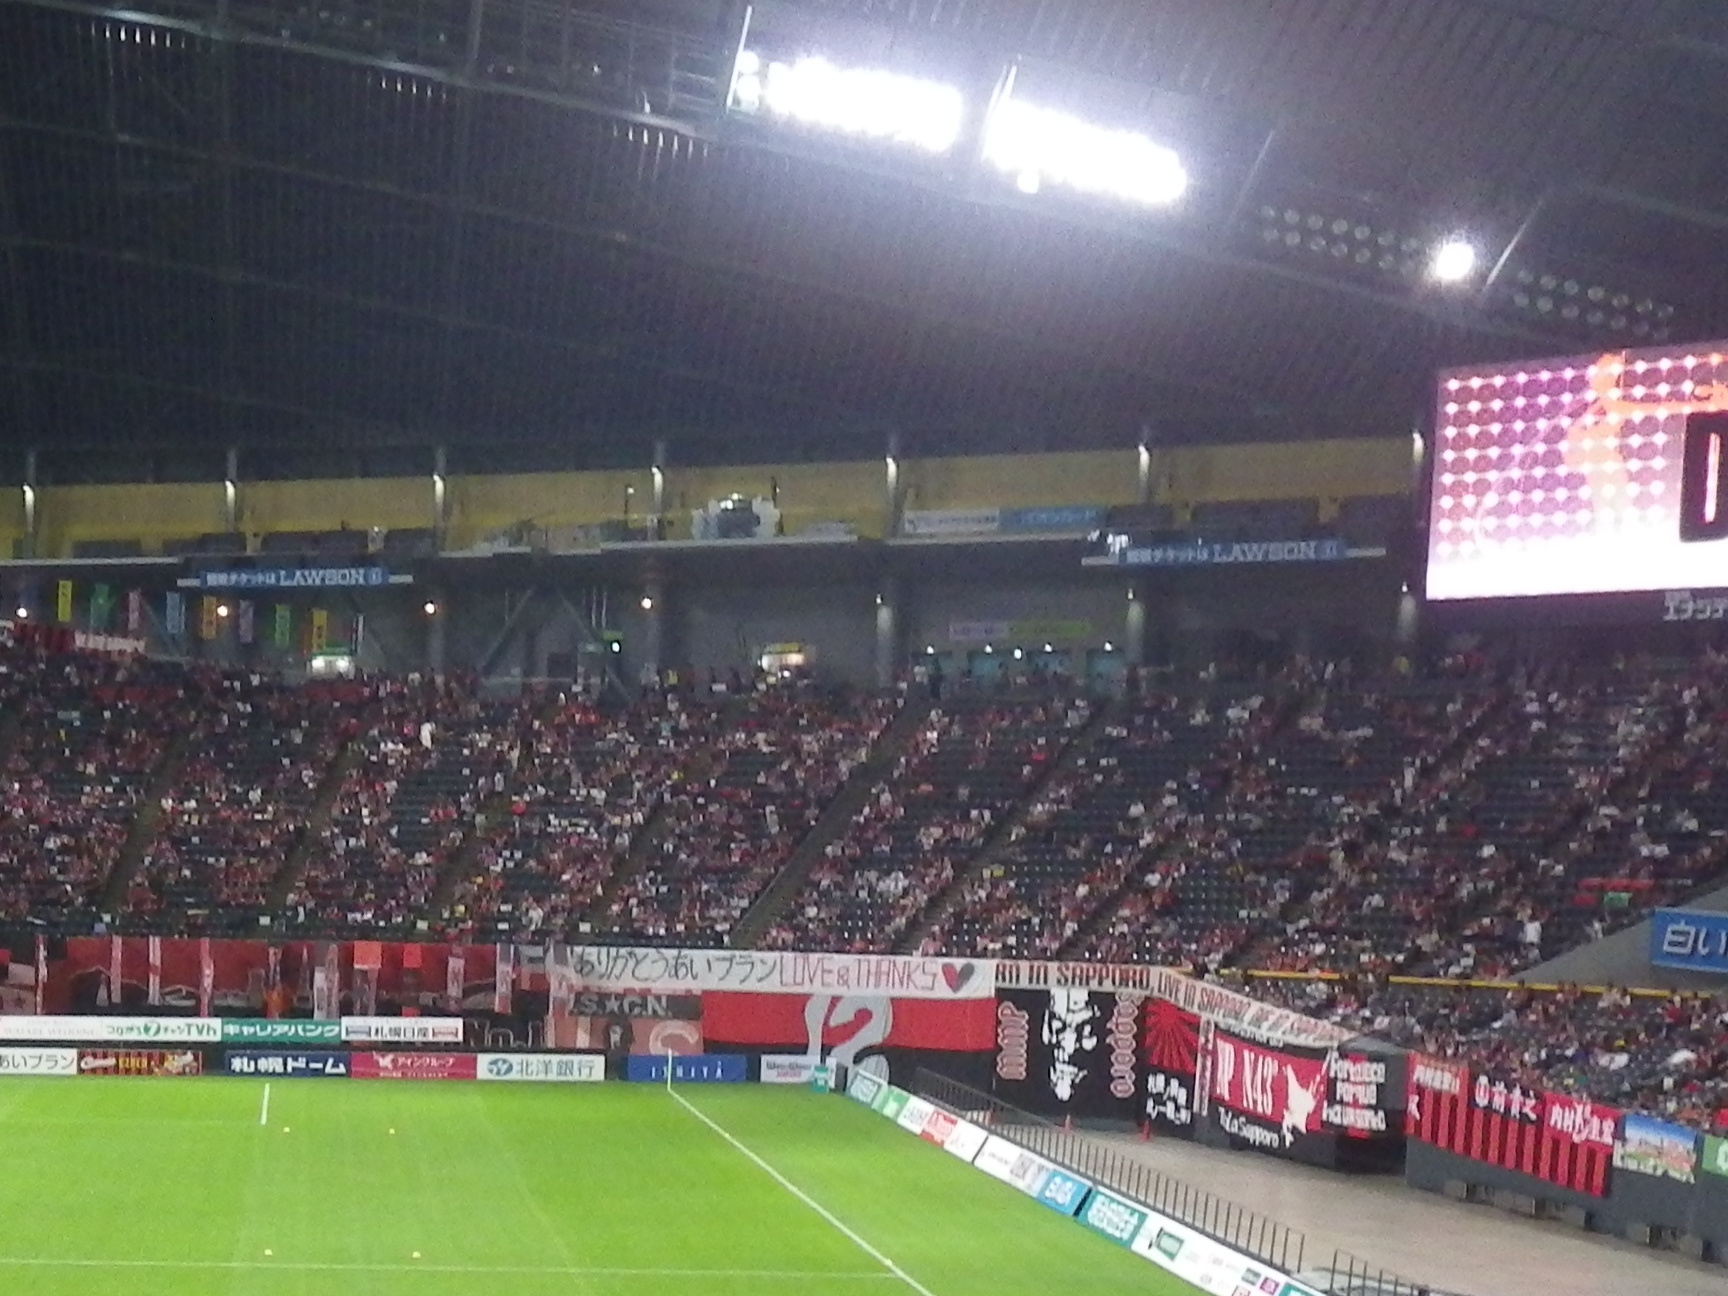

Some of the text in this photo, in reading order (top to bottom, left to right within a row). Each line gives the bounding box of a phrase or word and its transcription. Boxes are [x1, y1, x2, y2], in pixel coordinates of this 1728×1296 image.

[278, 568, 366, 586] LAWSON
[229, 1055, 348, 1075] 札幌ドーム
[515, 1058, 596, 1078] 北洋銀行
